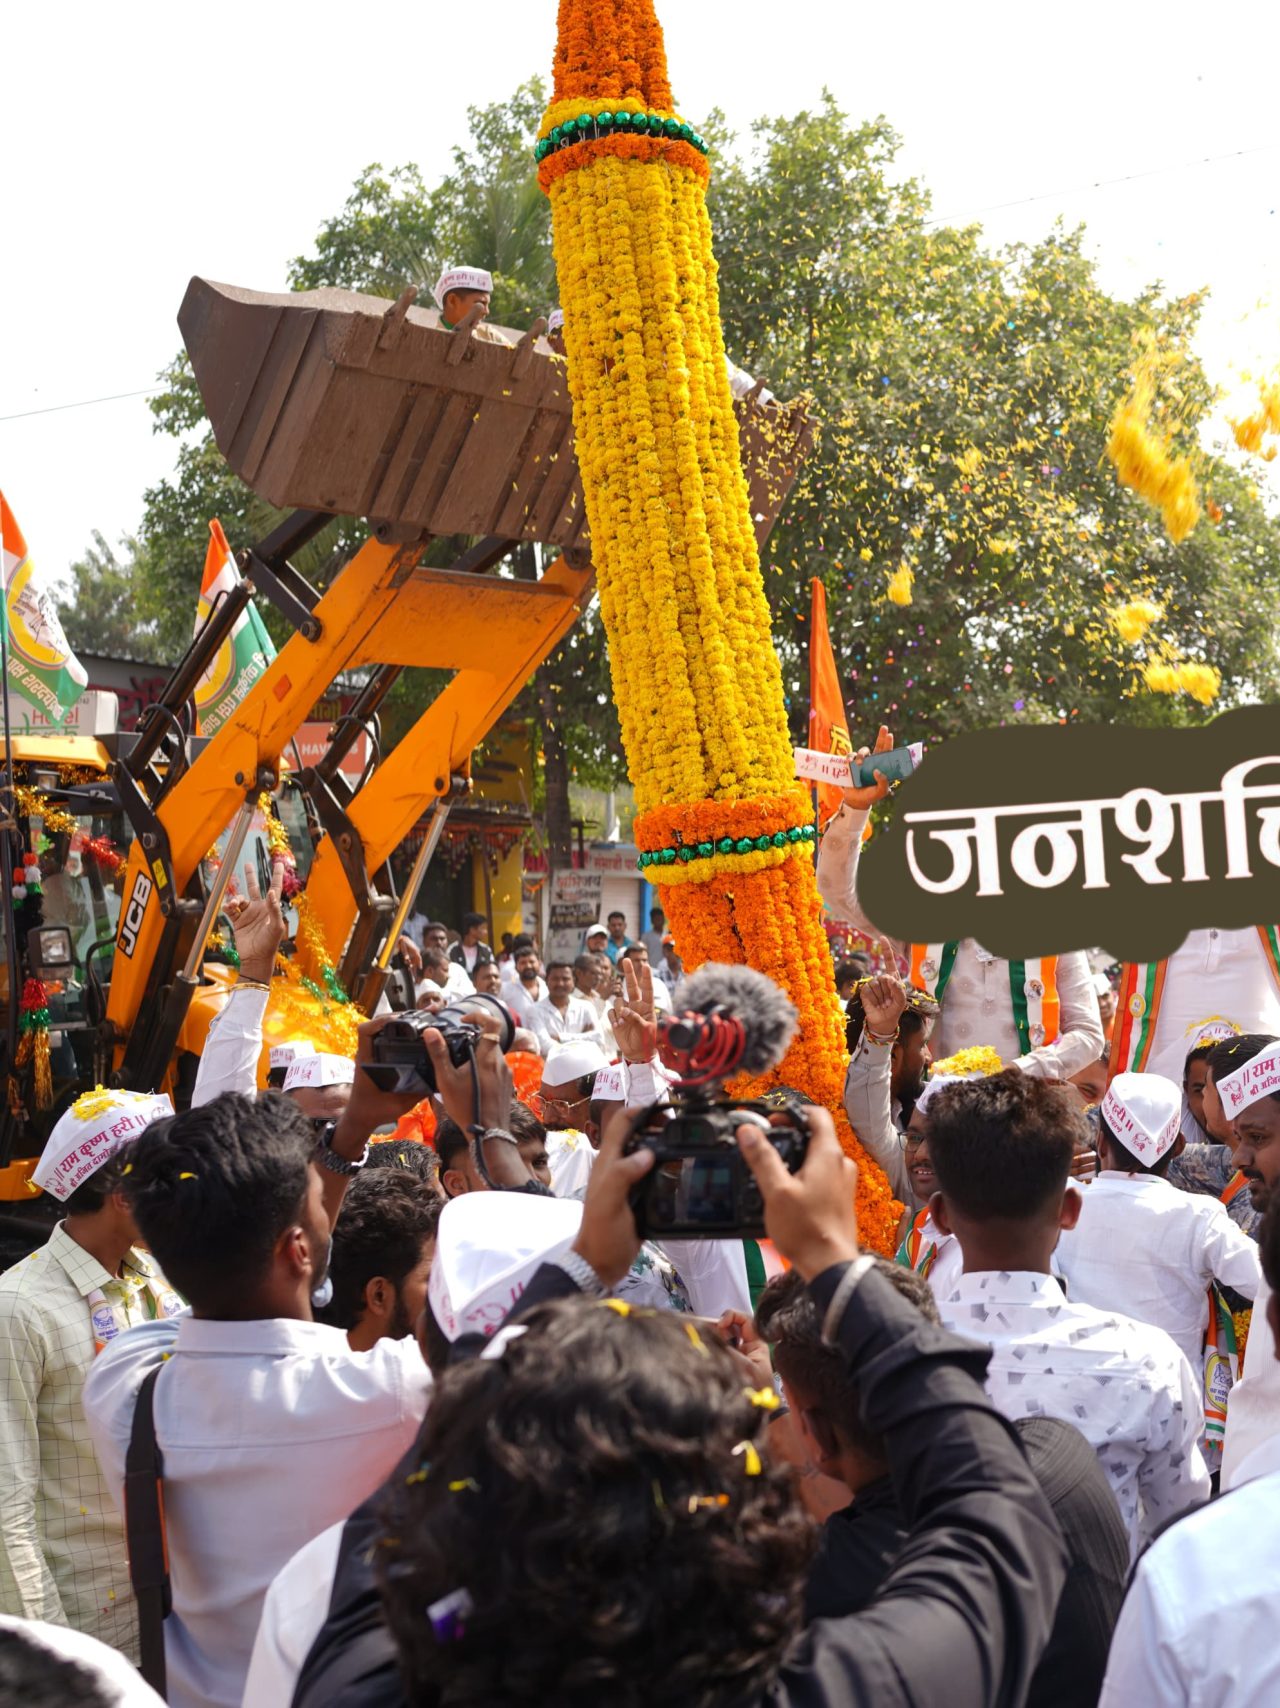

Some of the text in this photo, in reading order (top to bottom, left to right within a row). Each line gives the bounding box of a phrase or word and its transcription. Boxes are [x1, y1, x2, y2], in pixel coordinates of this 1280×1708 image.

[32, 706, 79, 724] Hel
[122, 873, 153, 956] JCB
[1252, 1058, 1275, 1078] राम
[60, 1151, 80, 1172] राम
[78, 1130, 110, 1157] कृष्ण
[109, 1116, 134, 1138] हरी
[76, 1162, 93, 1181] अजित
